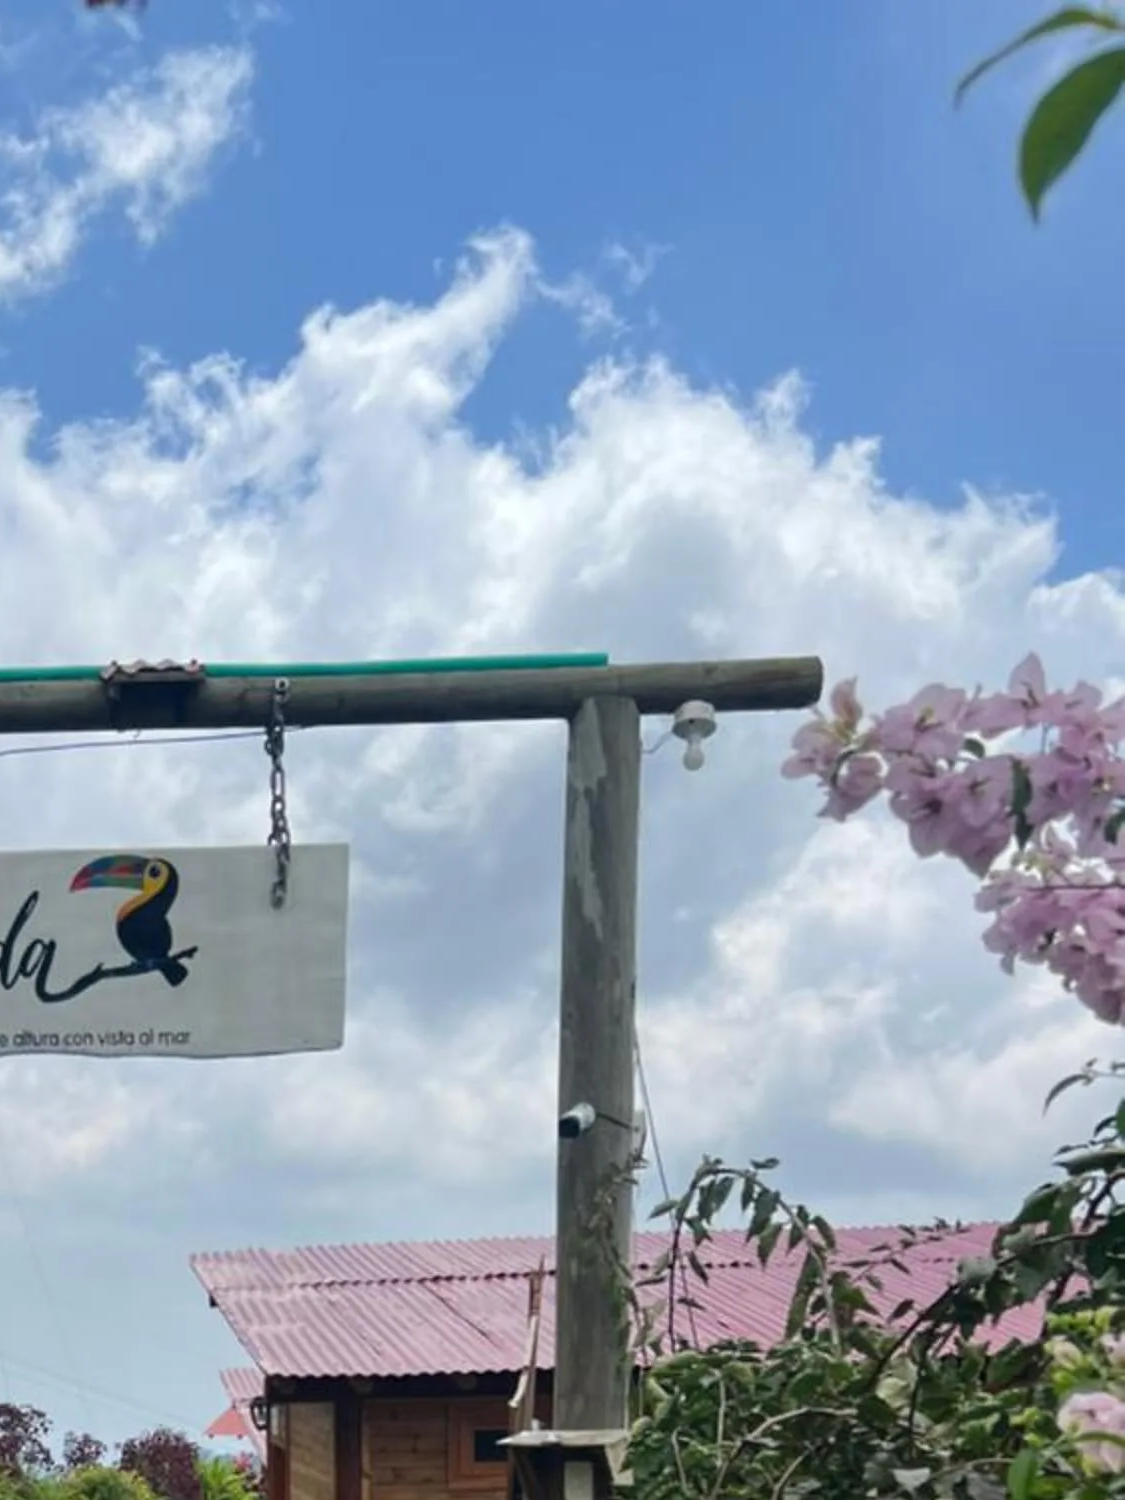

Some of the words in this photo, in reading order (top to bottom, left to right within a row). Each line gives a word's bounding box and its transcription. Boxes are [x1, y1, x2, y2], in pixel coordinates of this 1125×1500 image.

[12, 1029, 59, 1046] altura
[62, 1032, 95, 1047] con
[98, 1029, 135, 1046] vista
[138, 1028, 155, 1046] al
[157, 1031, 191, 1045] mar
